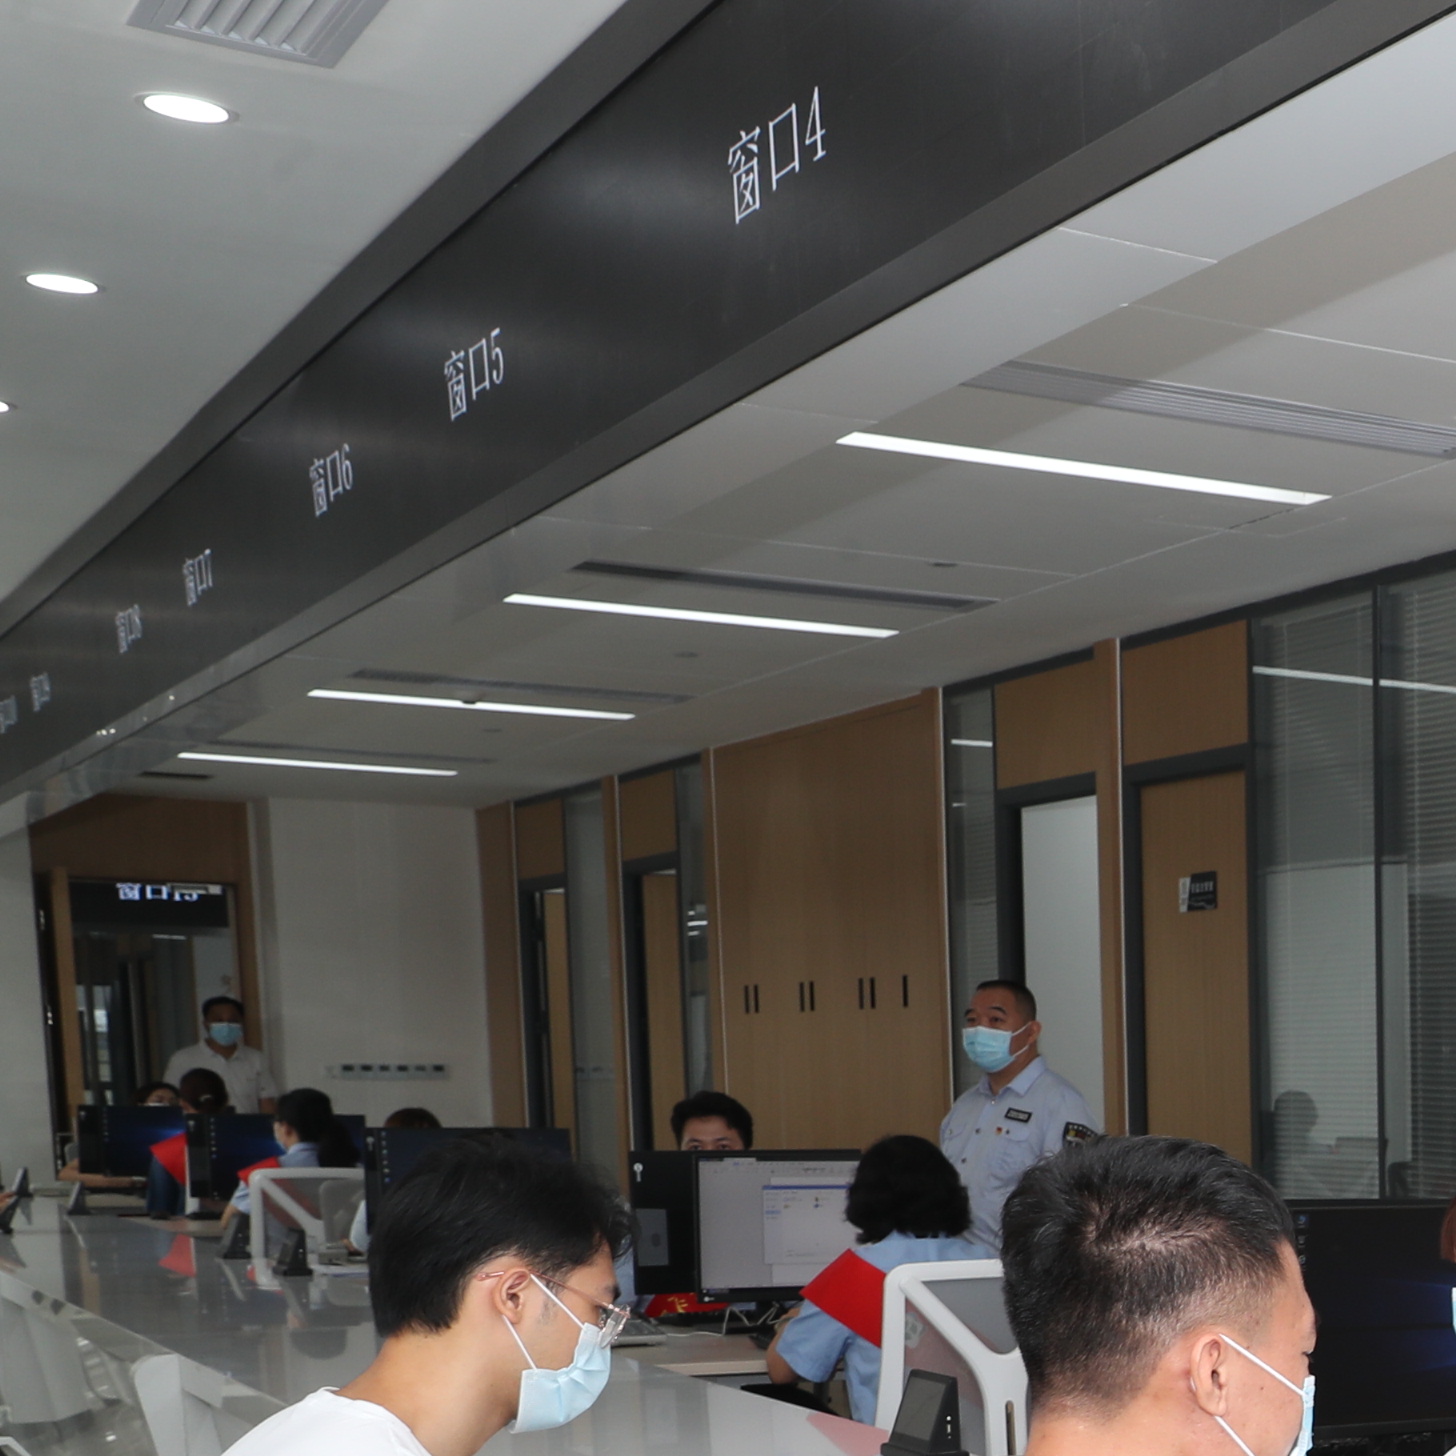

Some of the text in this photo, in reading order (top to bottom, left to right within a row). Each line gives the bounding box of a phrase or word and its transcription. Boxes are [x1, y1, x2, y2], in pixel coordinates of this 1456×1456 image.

[728, 85, 827, 225] 窗口4
[444, 327, 504, 421] 窗口5
[309, 443, 353, 516] 窗口6
